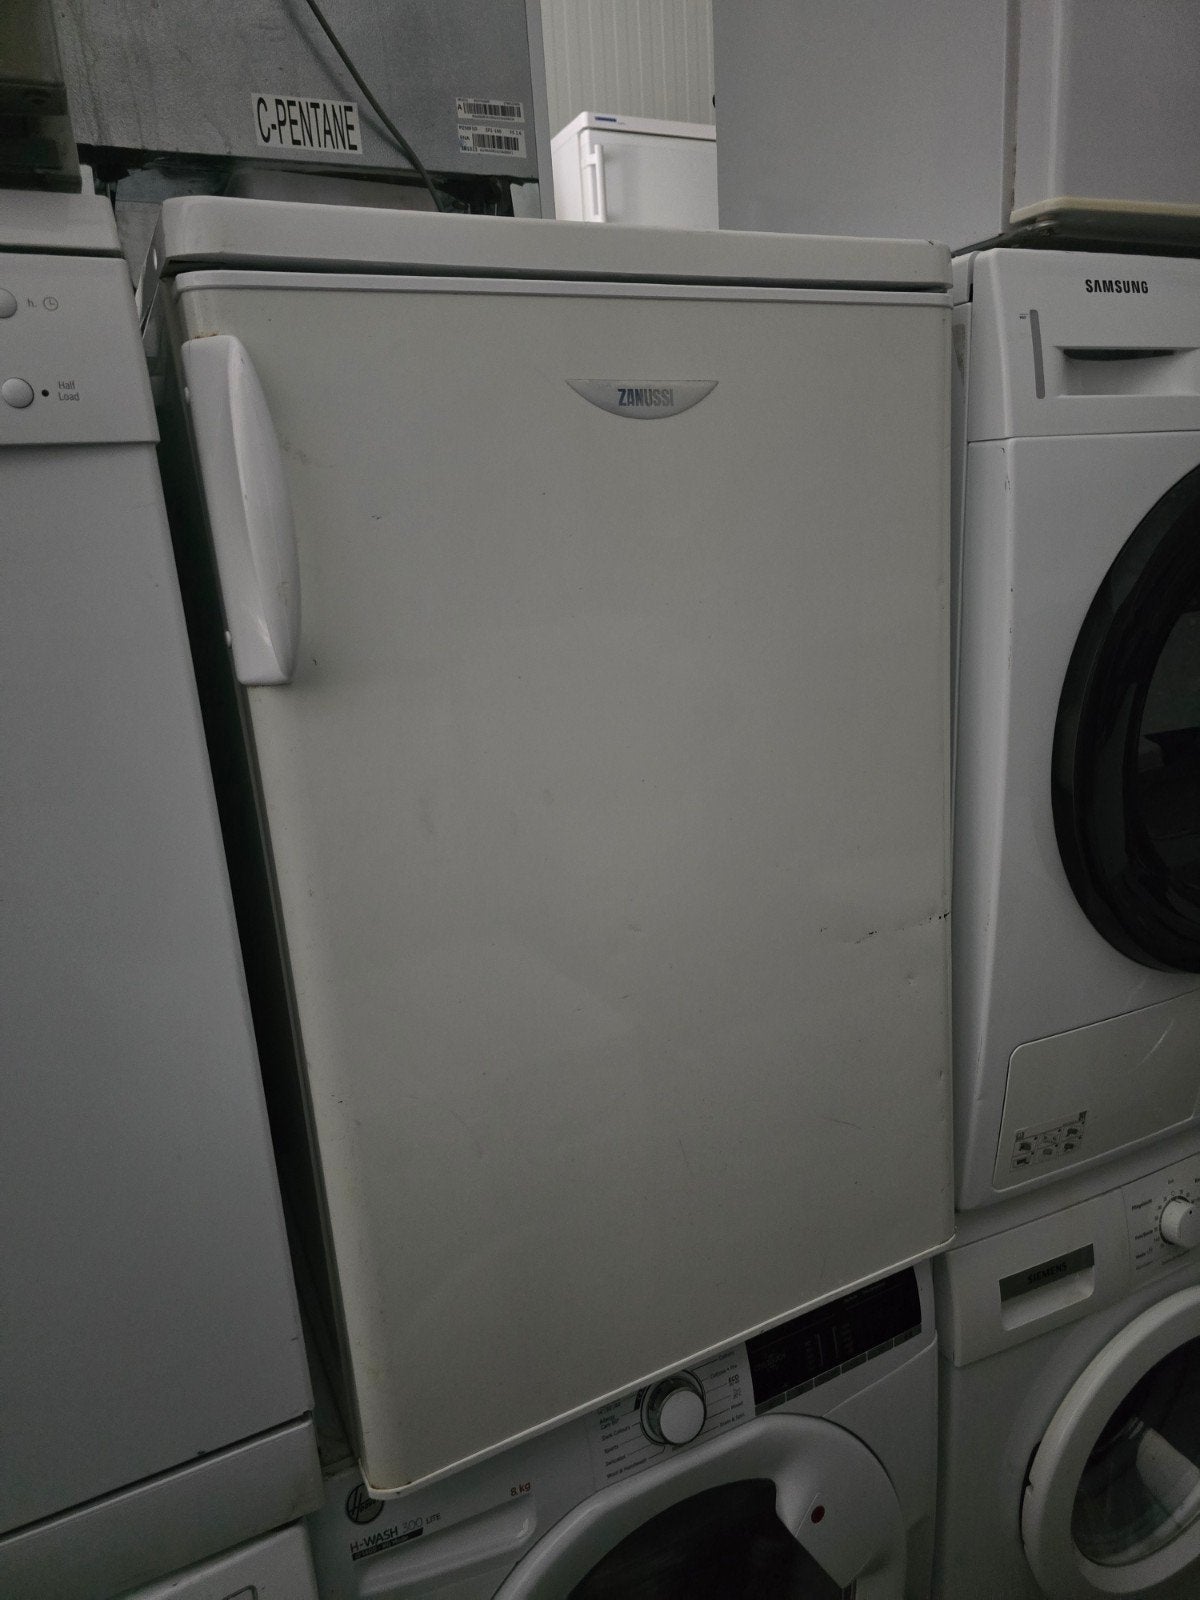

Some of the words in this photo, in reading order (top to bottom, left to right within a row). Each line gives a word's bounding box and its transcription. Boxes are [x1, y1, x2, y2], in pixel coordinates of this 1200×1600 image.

[257, 97, 358, 151] C-PENTANE
[1085, 279, 1149, 294] SAMSUNG
[58, 380, 75, 390] Half
[58, 391, 80, 401] Load
[617, 388, 674, 407] ZANUSSI
[1028, 1262, 1067, 1284] SIEMENS
[729, 1374, 739, 1382] ECO
[511, 1487, 517, 1496] 8
[519, 1482, 530, 1493] kg
[350, 1526, 398, 1553] H-WASH
[402, 1517, 422, 1533] 300
[426, 1513, 441, 1525] LITE
